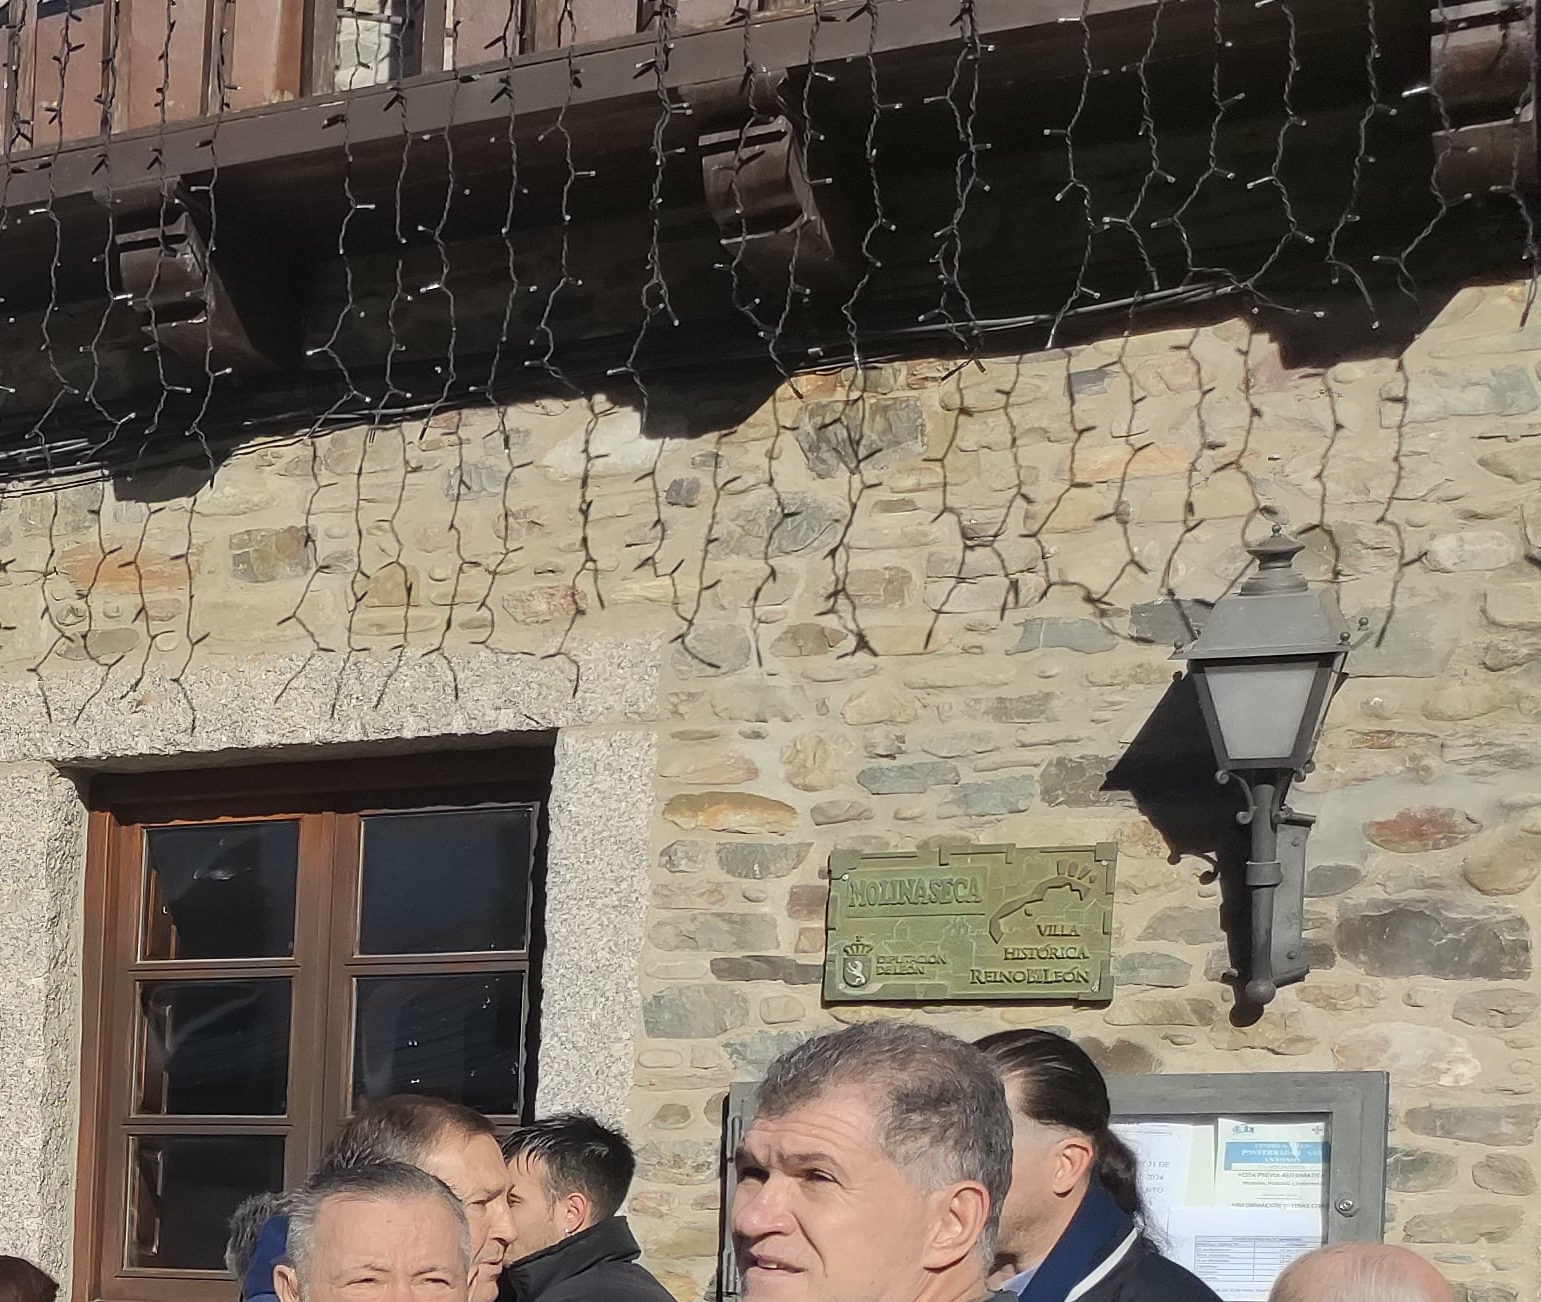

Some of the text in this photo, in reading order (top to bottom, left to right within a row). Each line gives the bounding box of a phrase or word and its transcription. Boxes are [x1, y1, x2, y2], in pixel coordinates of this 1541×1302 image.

[848, 877, 983, 908] MOLINASECA
[1036, 924, 1081, 937] VILLA
[876, 953, 948, 965] DIPUTACIÓN
[1003, 944, 1090, 960] HISTÓRICA
[876, 964, 925, 975] DE LEÓN
[970, 968, 1026, 985] REINO
[1043, 966, 1090, 985] LEÓN
